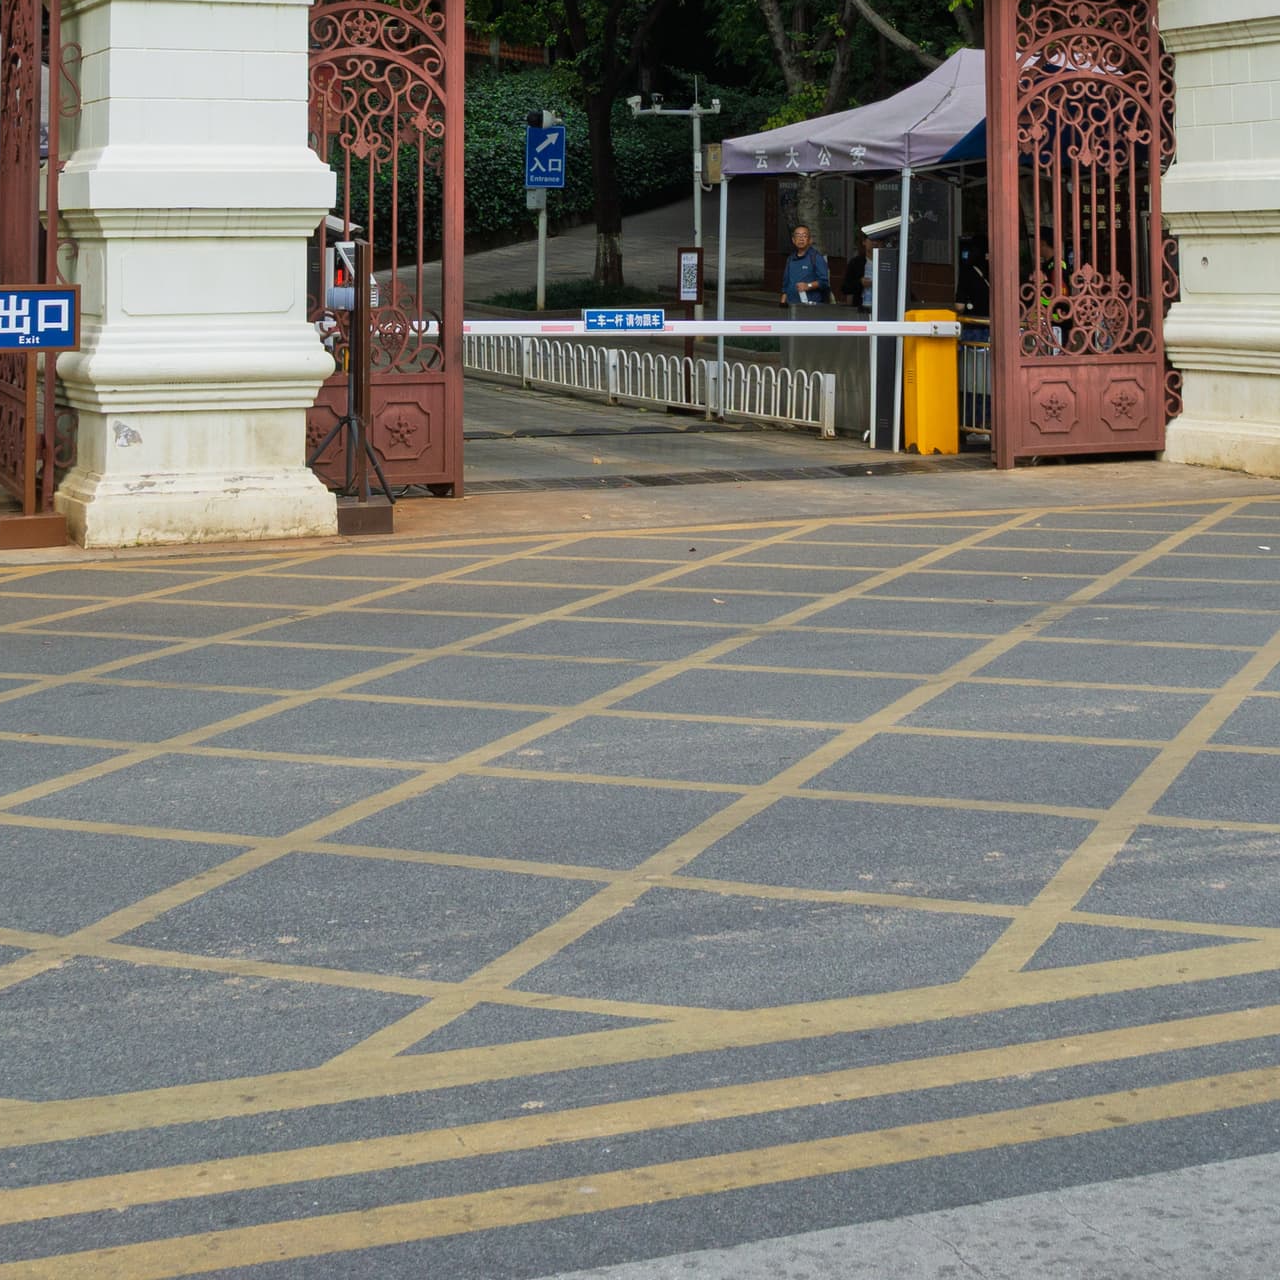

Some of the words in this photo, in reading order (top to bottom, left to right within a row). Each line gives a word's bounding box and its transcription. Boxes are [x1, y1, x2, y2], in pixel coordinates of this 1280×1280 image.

[755, 144, 867, 169] 云大公安
[529, 156, 562, 172] 入口
[529, 175, 560, 183] Entrance
[588, 313, 624, 327] 一车一杆
[625, 313, 661, 327] 请勿跟车
[18, 335, 40, 344] Exit
